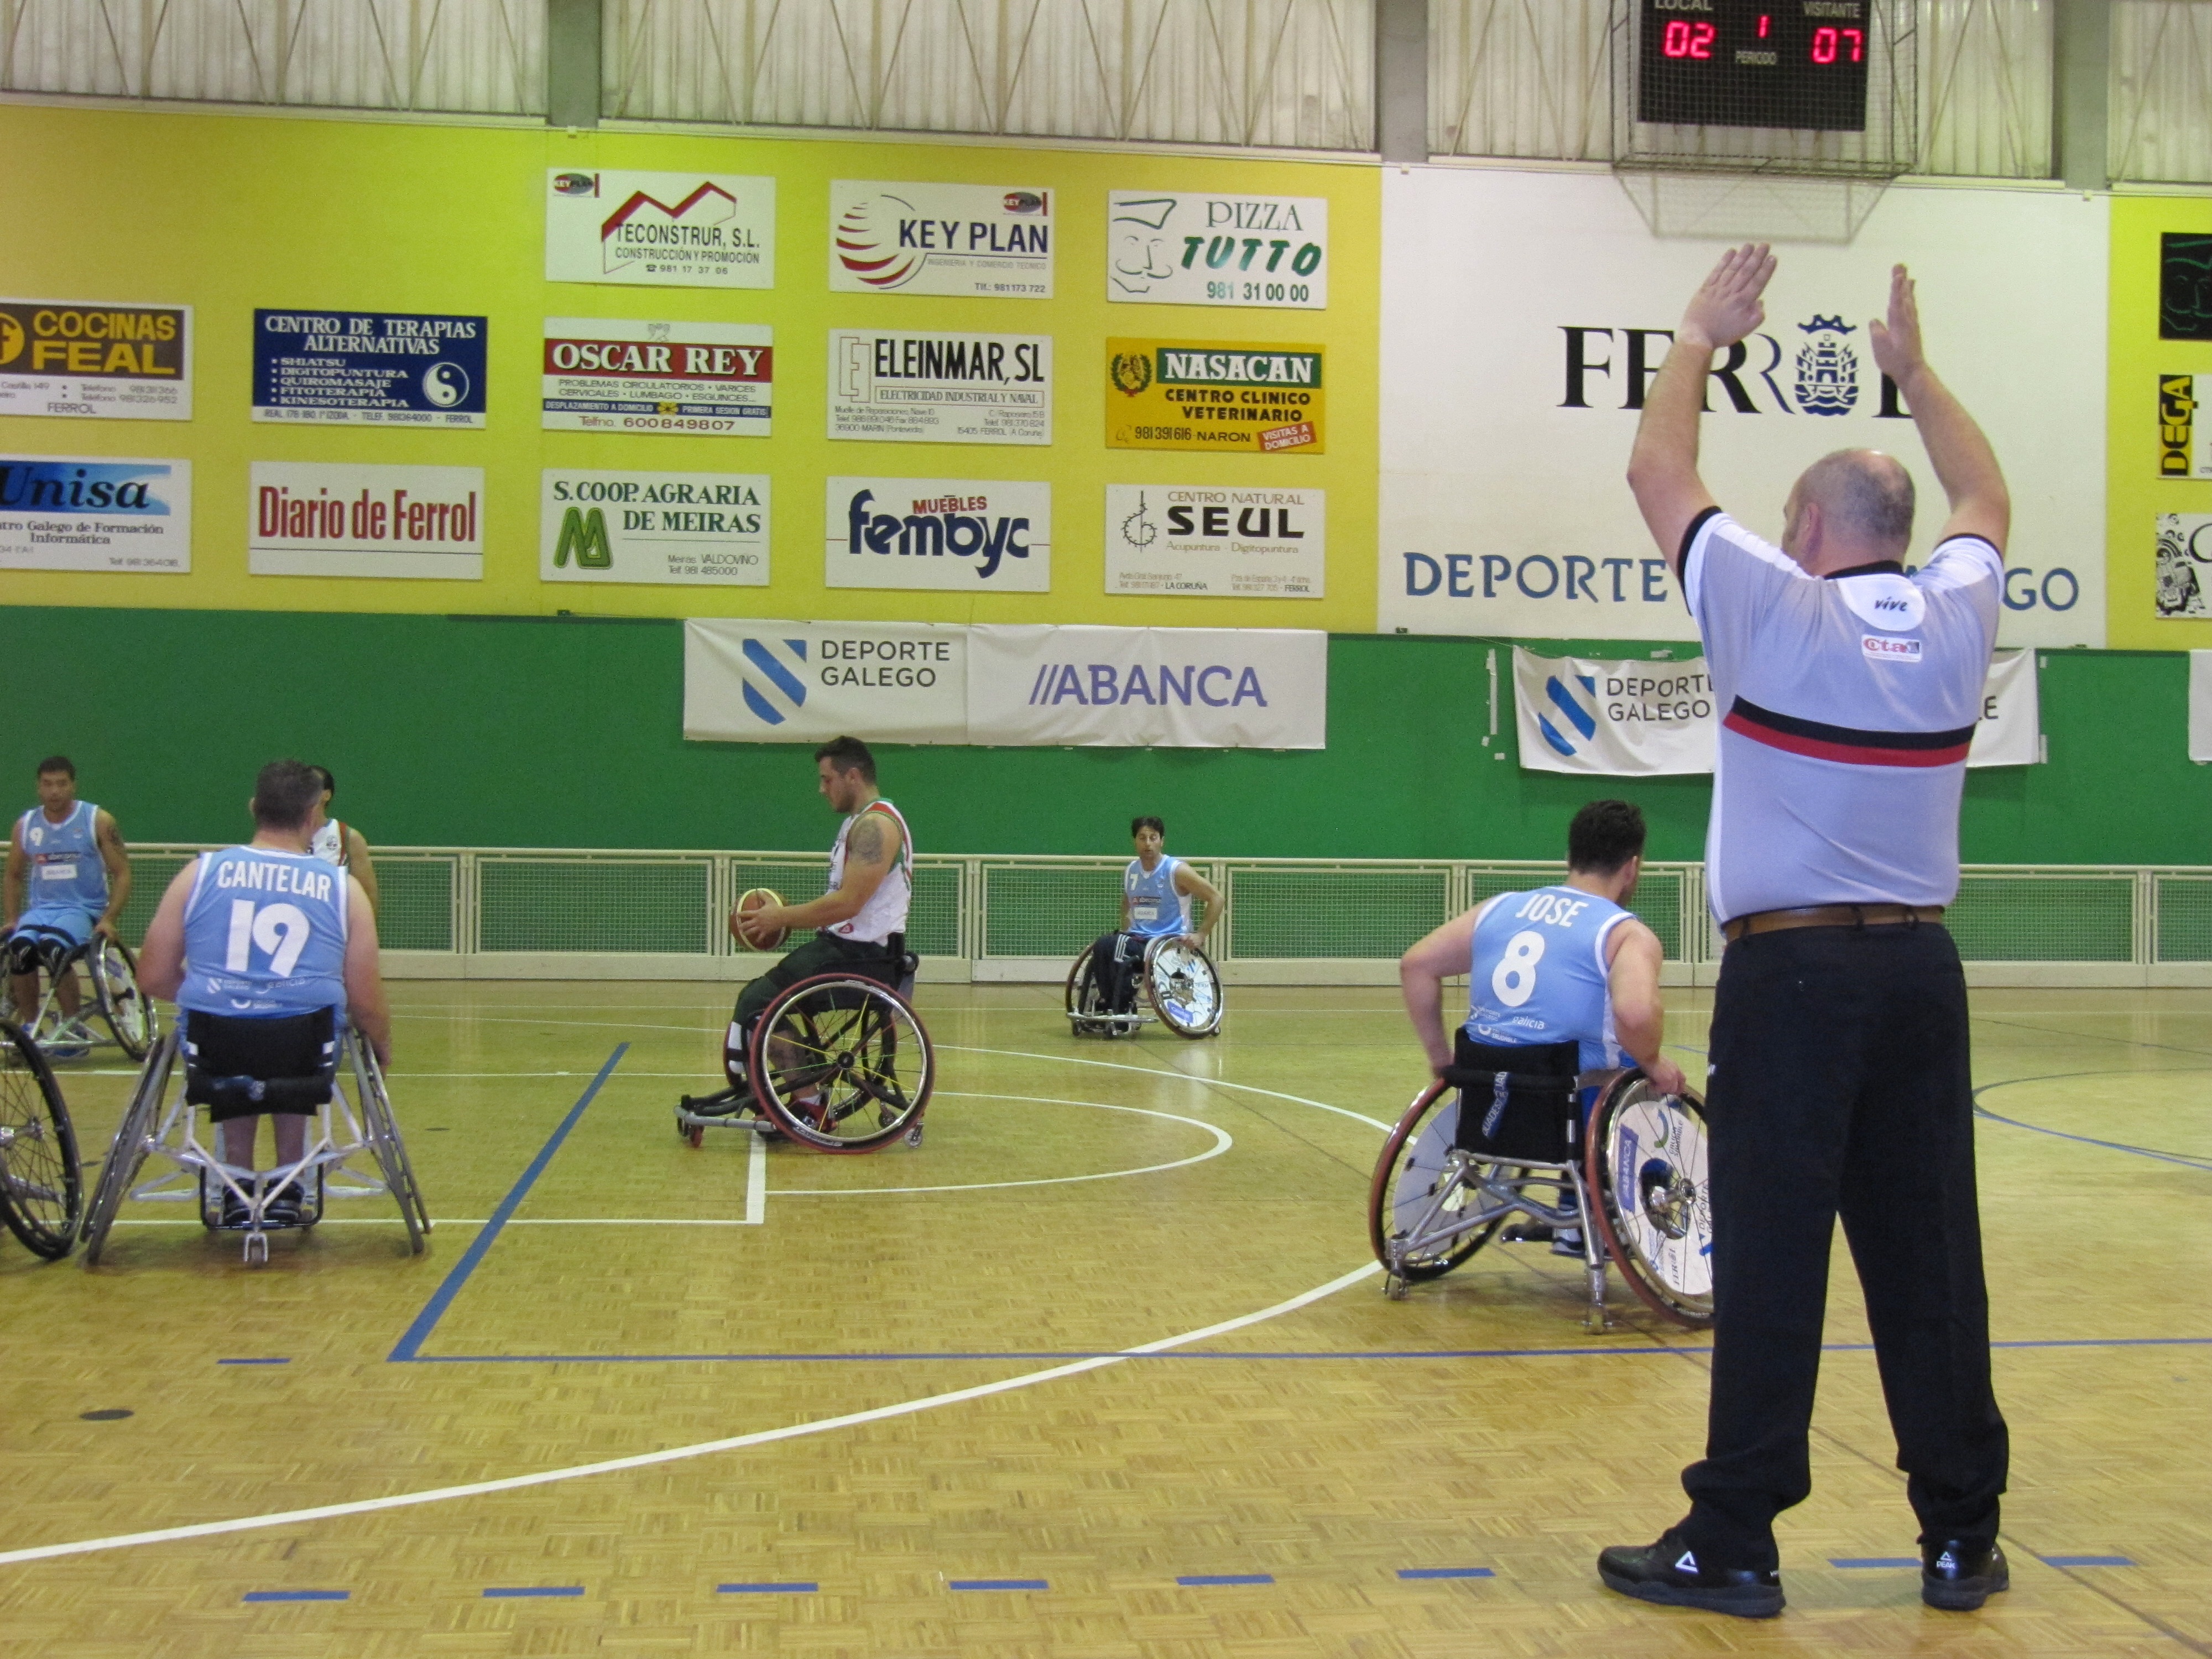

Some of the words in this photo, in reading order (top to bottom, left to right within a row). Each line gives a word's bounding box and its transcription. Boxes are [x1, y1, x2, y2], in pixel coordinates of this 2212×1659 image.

[1804, 2, 1861, 19] VISITANTE
[1758, 15, 1770, 38] 1
[1664, 20, 1717, 59] 02
[1812, 27, 1863, 64] 07
[1206, 201, 1303, 231] PIZZA
[733, 228, 760, 248] S.L.
[899, 219, 959, 250] KEY
[969, 221, 1048, 253] PLAN
[693, 252, 699, 260] Y
[1181, 236, 1322, 277] TUTTO
[1029, 284, 1046, 293] 722
[1207, 281, 1234, 299] 981
[1243, 283, 1260, 300] 31
[1290, 285, 1309, 302] 00
[33, 310, 176, 342] COCINAS
[265, 315, 341, 335] CENTRO
[349, 318, 373, 336] DE
[384, 320, 476, 339] TERAPIAS
[304, 335, 440, 355] ALTERNATIVAS
[32, 340, 176, 375] FEAL
[280, 357, 347, 367] SHIATSU
[553, 343, 673, 373] OSCAR
[685, 347, 764, 377] REY
[875, 338, 1011, 385] ELEINMAR,
[1014, 343, 1045, 383] SL
[1165, 352, 1313, 383] NASACAN
[280, 367, 409, 379] DIGITOPUNTURA
[280, 377, 392, 389] QUIROMASAJE
[280, 387, 387, 398] FITOTERAPIA
[559, 379, 619, 389] PROBLEMAS
[623, 380, 705, 392] CIRCULATORIOS
[715, 383, 757, 393] VARICES
[559, 389, 619, 398] CERVICALES
[630, 390, 683, 400] LUMBAGO
[280, 397, 410, 408] KINESOTERAPIA
[880, 390, 942, 401] ELECTRICIDAD
[945, 391, 998, 403] INDUSTRIAL
[1010, 394, 1039, 404] NAVAL
[1165, 388, 1235, 404] CENTRO
[1241, 391, 1311, 405] CLINICO
[47, 401, 96, 414] FERROL
[545, 401, 609, 411] DESPLAZAMIENTO
[682, 406, 713, 415] PRIMERA
[1182, 406, 1303, 422] VETERINARIO
[623, 417, 735, 431] 600849807
[1262, 426, 1298, 441] VISITAS
[1301, 424, 1309, 433] A
[1264, 434, 1311, 451] DOMICILIO
[0, 466, 150, 509] Unisa
[554, 481, 573, 500] S.
[576, 482, 639, 503] COOP.
[641, 483, 761, 505] AGRARIA
[912, 495, 988, 514] MUEBLES
[1167, 491, 1227, 503] CENTRO
[1231, 493, 1306, 506] NATURAL
[259, 486, 345, 539] Diario
[352, 488, 387, 540] de
[394, 489, 477, 542] Ferrol
[623, 510, 656, 531] DE
[661, 511, 761, 534] MEIRAS
[1167, 505, 1305, 539] SEUL
[28, 520, 73, 534] Galego
[77, 522, 91, 533] de
[1166, 541, 1219, 552] Acupuntura
[1231, 542, 1298, 555] Digitopuntura
[1403, 552, 1668, 603] DEPORTE
[821, 640, 950, 662] DEPORTE
[821, 666, 936, 687] GALEGO
[1608, 700, 1710, 722] GALEGO
[30, 827, 44, 846] 9
[217, 859, 333, 903] CANTELAR
[1130, 874, 1139, 891] 7
[1515, 892, 1589, 928] JOSE
[226, 898, 311, 978] 19
[1491, 930, 1546, 1008] 8
[1936, 1560, 1956, 1569] PEAK
